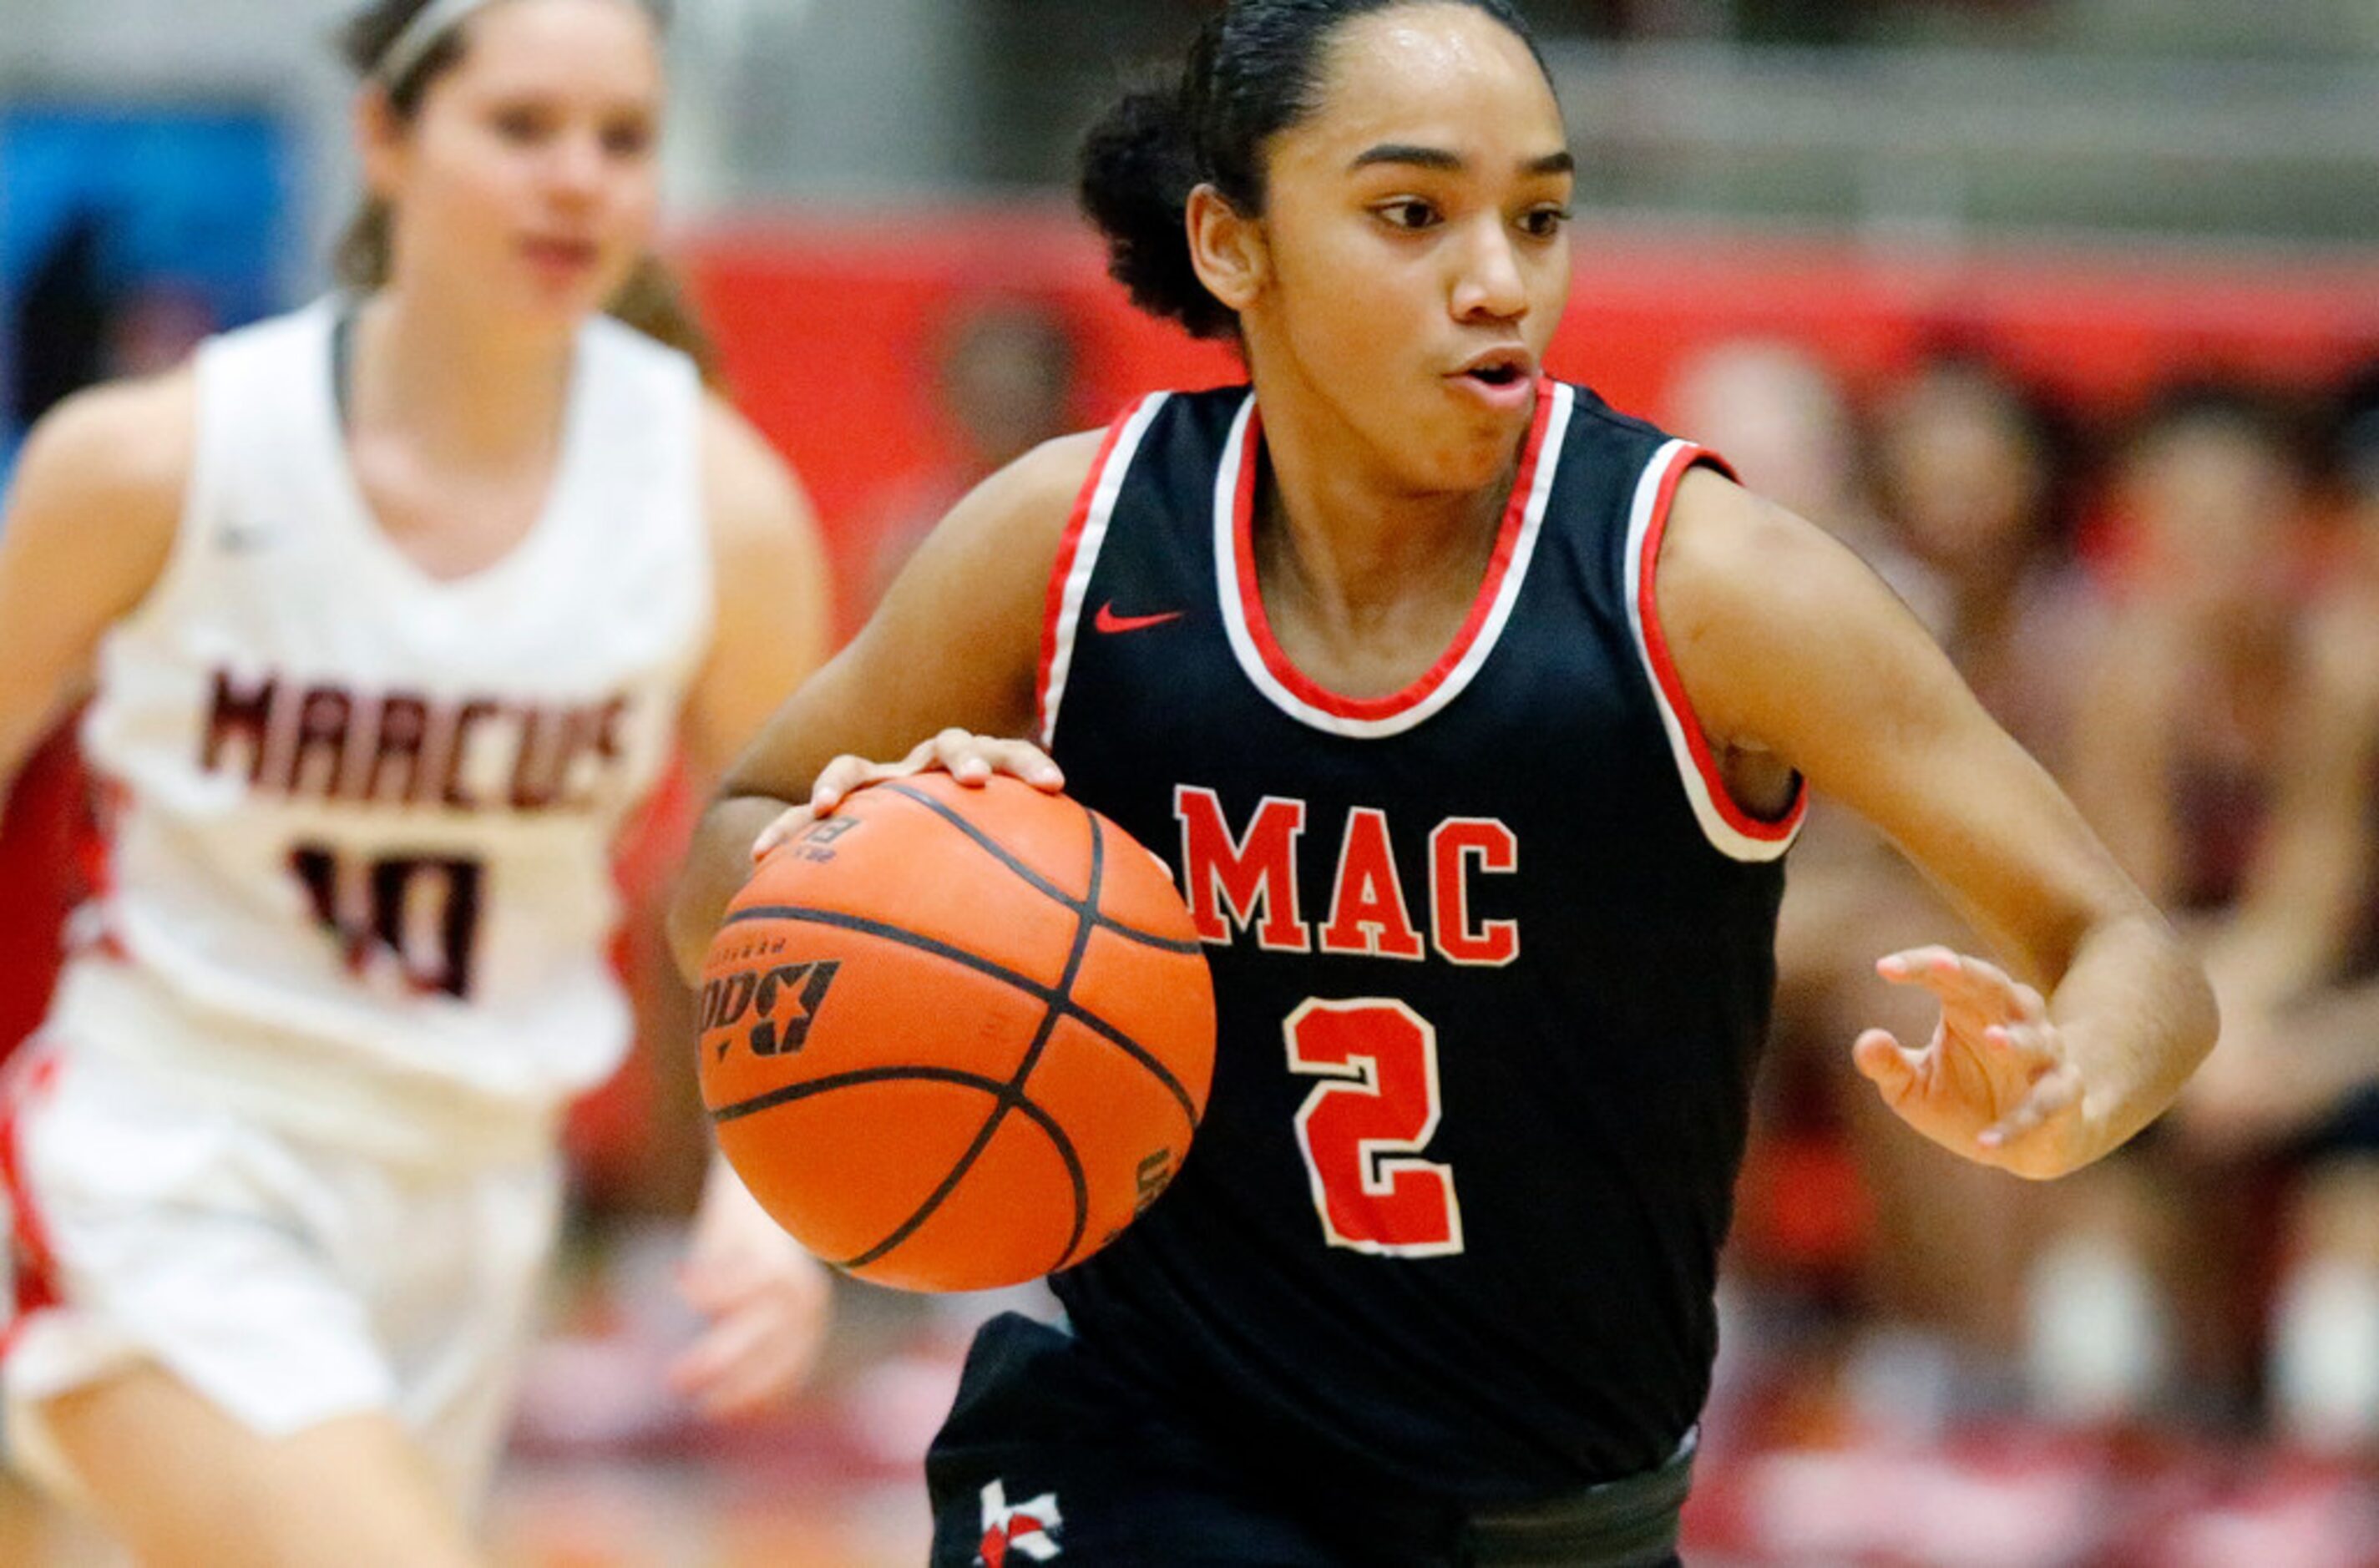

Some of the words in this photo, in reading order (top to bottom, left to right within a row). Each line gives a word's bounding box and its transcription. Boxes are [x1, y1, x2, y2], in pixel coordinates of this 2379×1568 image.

[200, 665, 631, 813] MARCUS
[287, 843, 483, 1002] 10
[1174, 783, 1520, 967] MAC
[1283, 997, 1464, 1259] 2
